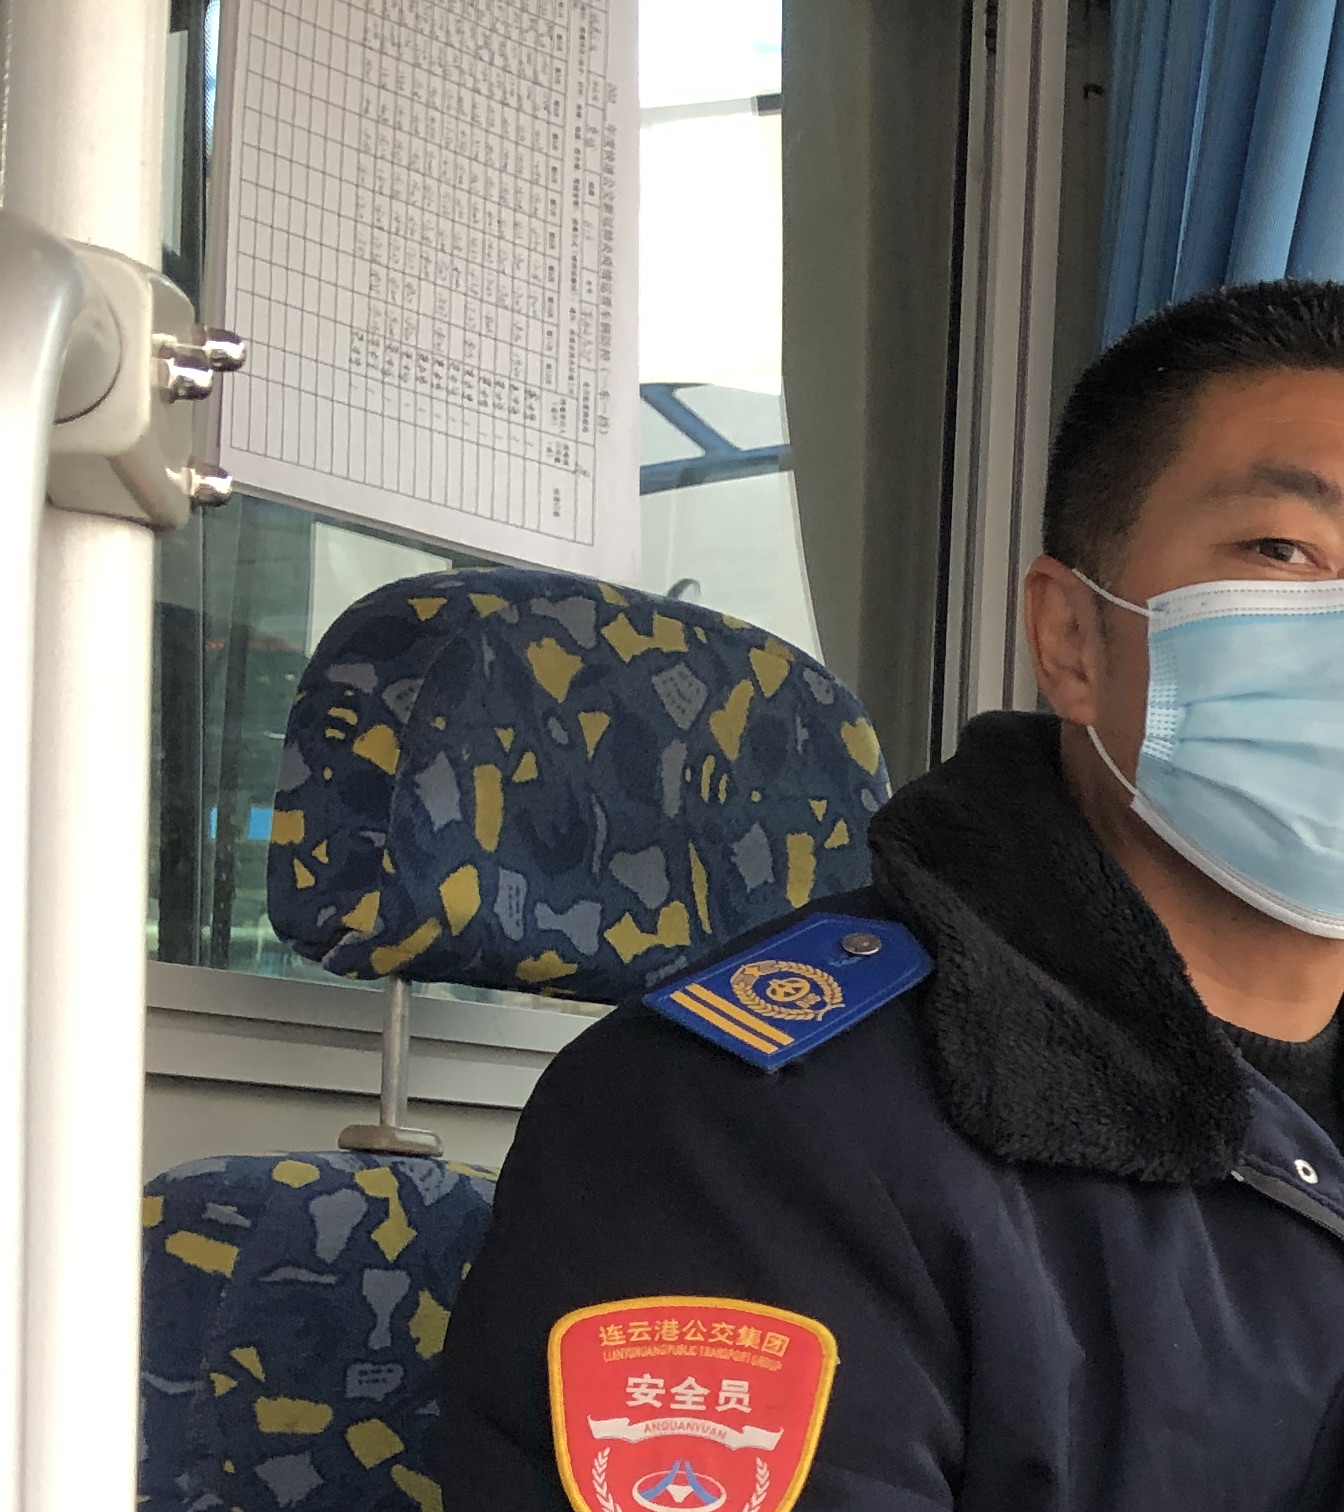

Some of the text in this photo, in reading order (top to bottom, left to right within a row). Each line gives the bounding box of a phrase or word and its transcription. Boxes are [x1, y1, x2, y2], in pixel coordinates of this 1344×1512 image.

[599, 1319, 791, 1357] 连云港公交集团
[625, 1373, 753, 1413] 安全员
